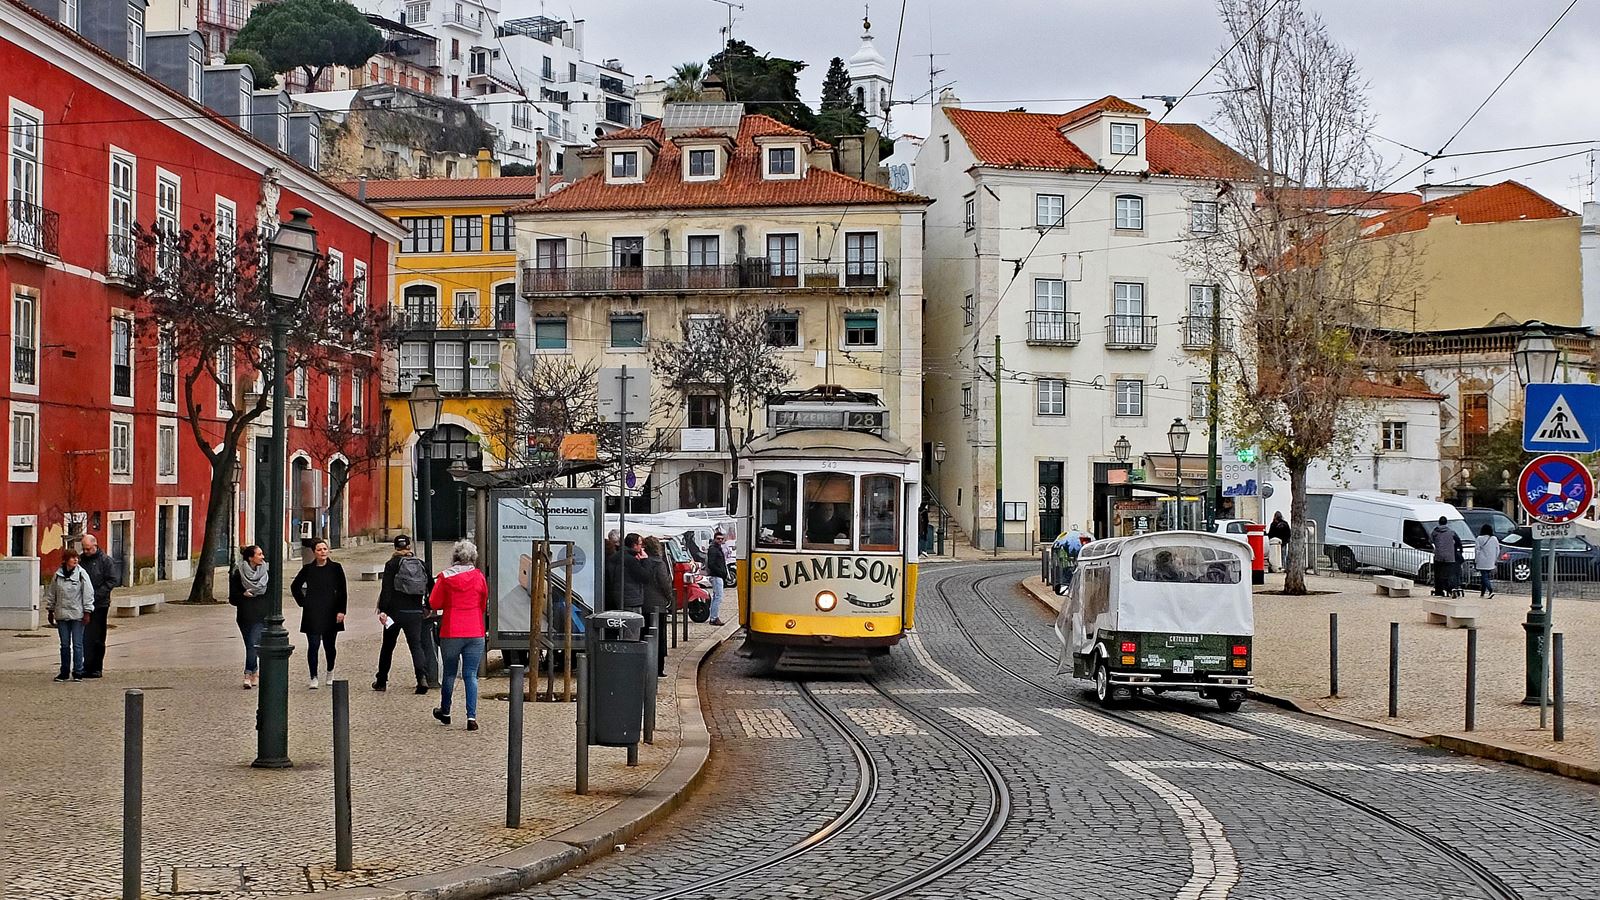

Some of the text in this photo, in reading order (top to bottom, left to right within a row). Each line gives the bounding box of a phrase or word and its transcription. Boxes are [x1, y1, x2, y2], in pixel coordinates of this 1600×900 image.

[853, 413, 875, 426] 28
[534, 506, 588, 514] Pone House
[779, 556, 899, 589] JAMESON
